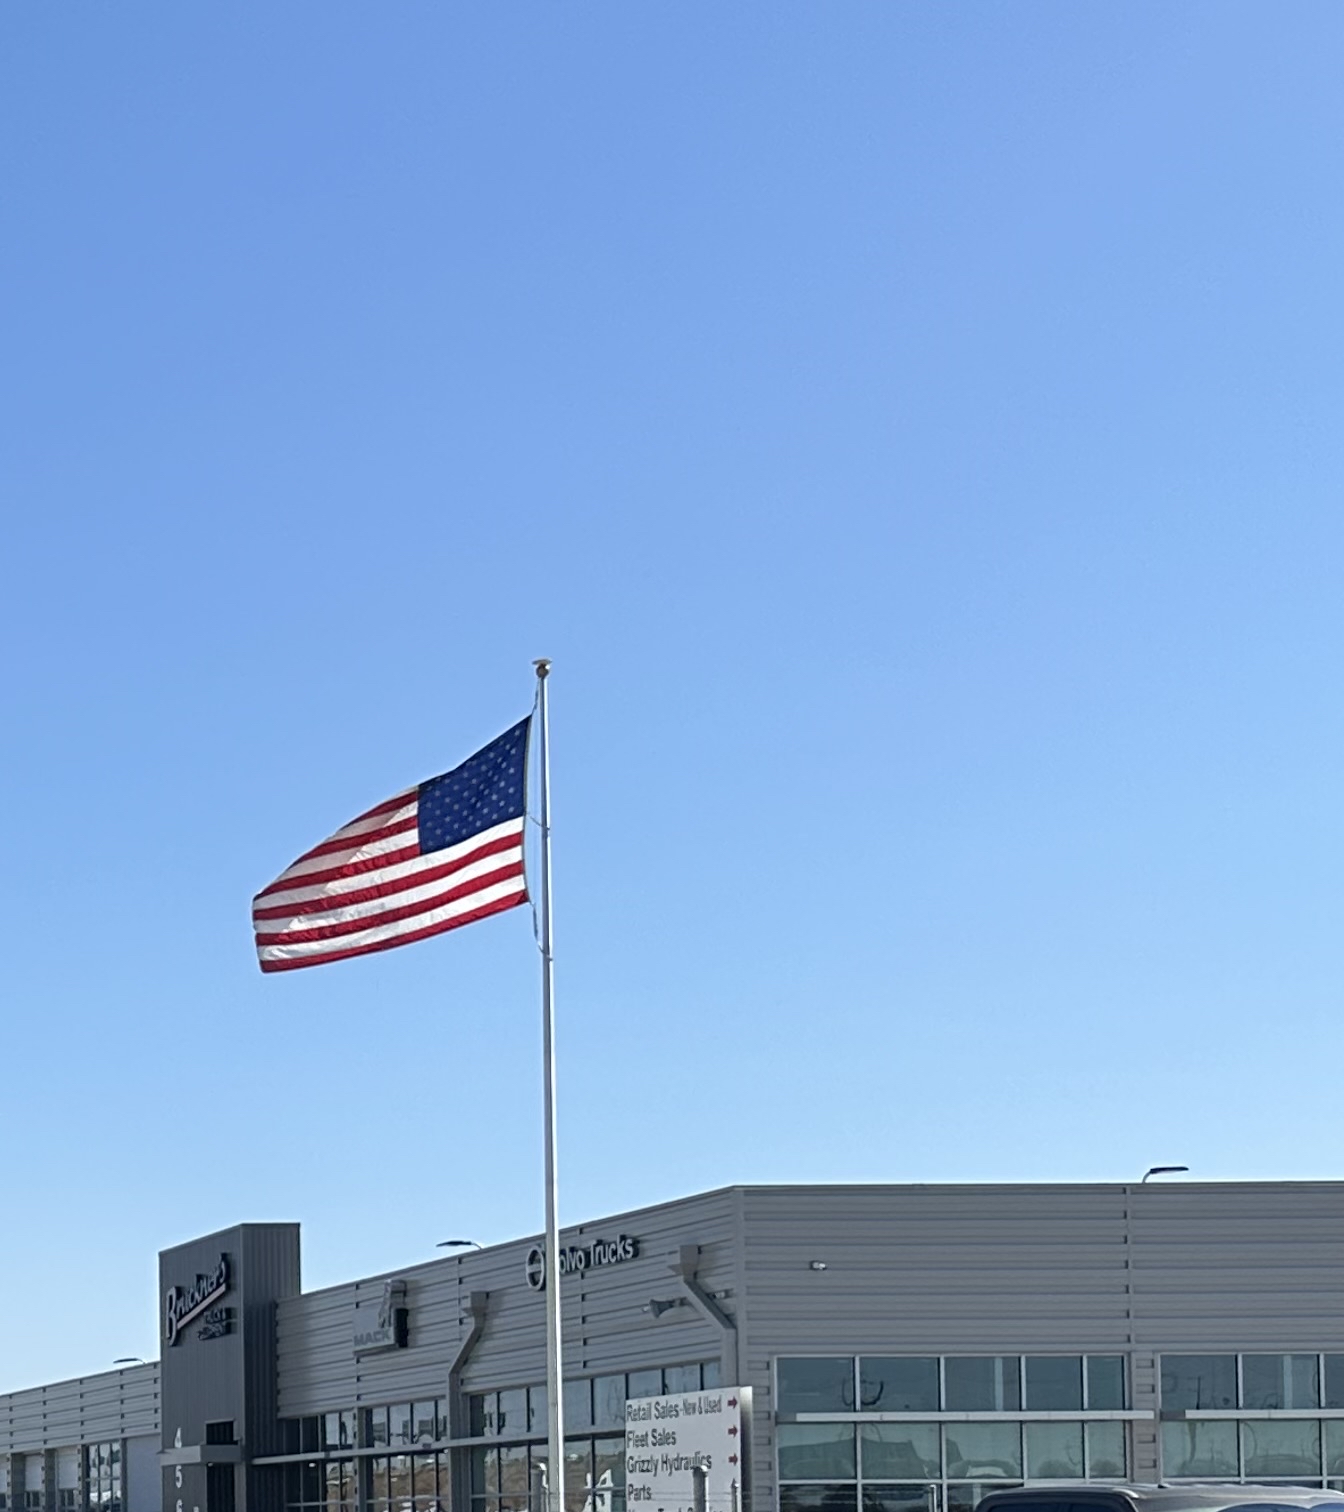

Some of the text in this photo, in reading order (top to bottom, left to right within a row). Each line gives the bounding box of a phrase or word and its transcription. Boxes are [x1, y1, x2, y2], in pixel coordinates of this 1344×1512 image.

[558, 1234, 633, 1275] olvo Trucks
[651, 1428, 677, 1447] Sales
[627, 1455, 658, 1477] Grizzly
[627, 1483, 652, 1501] Parts
